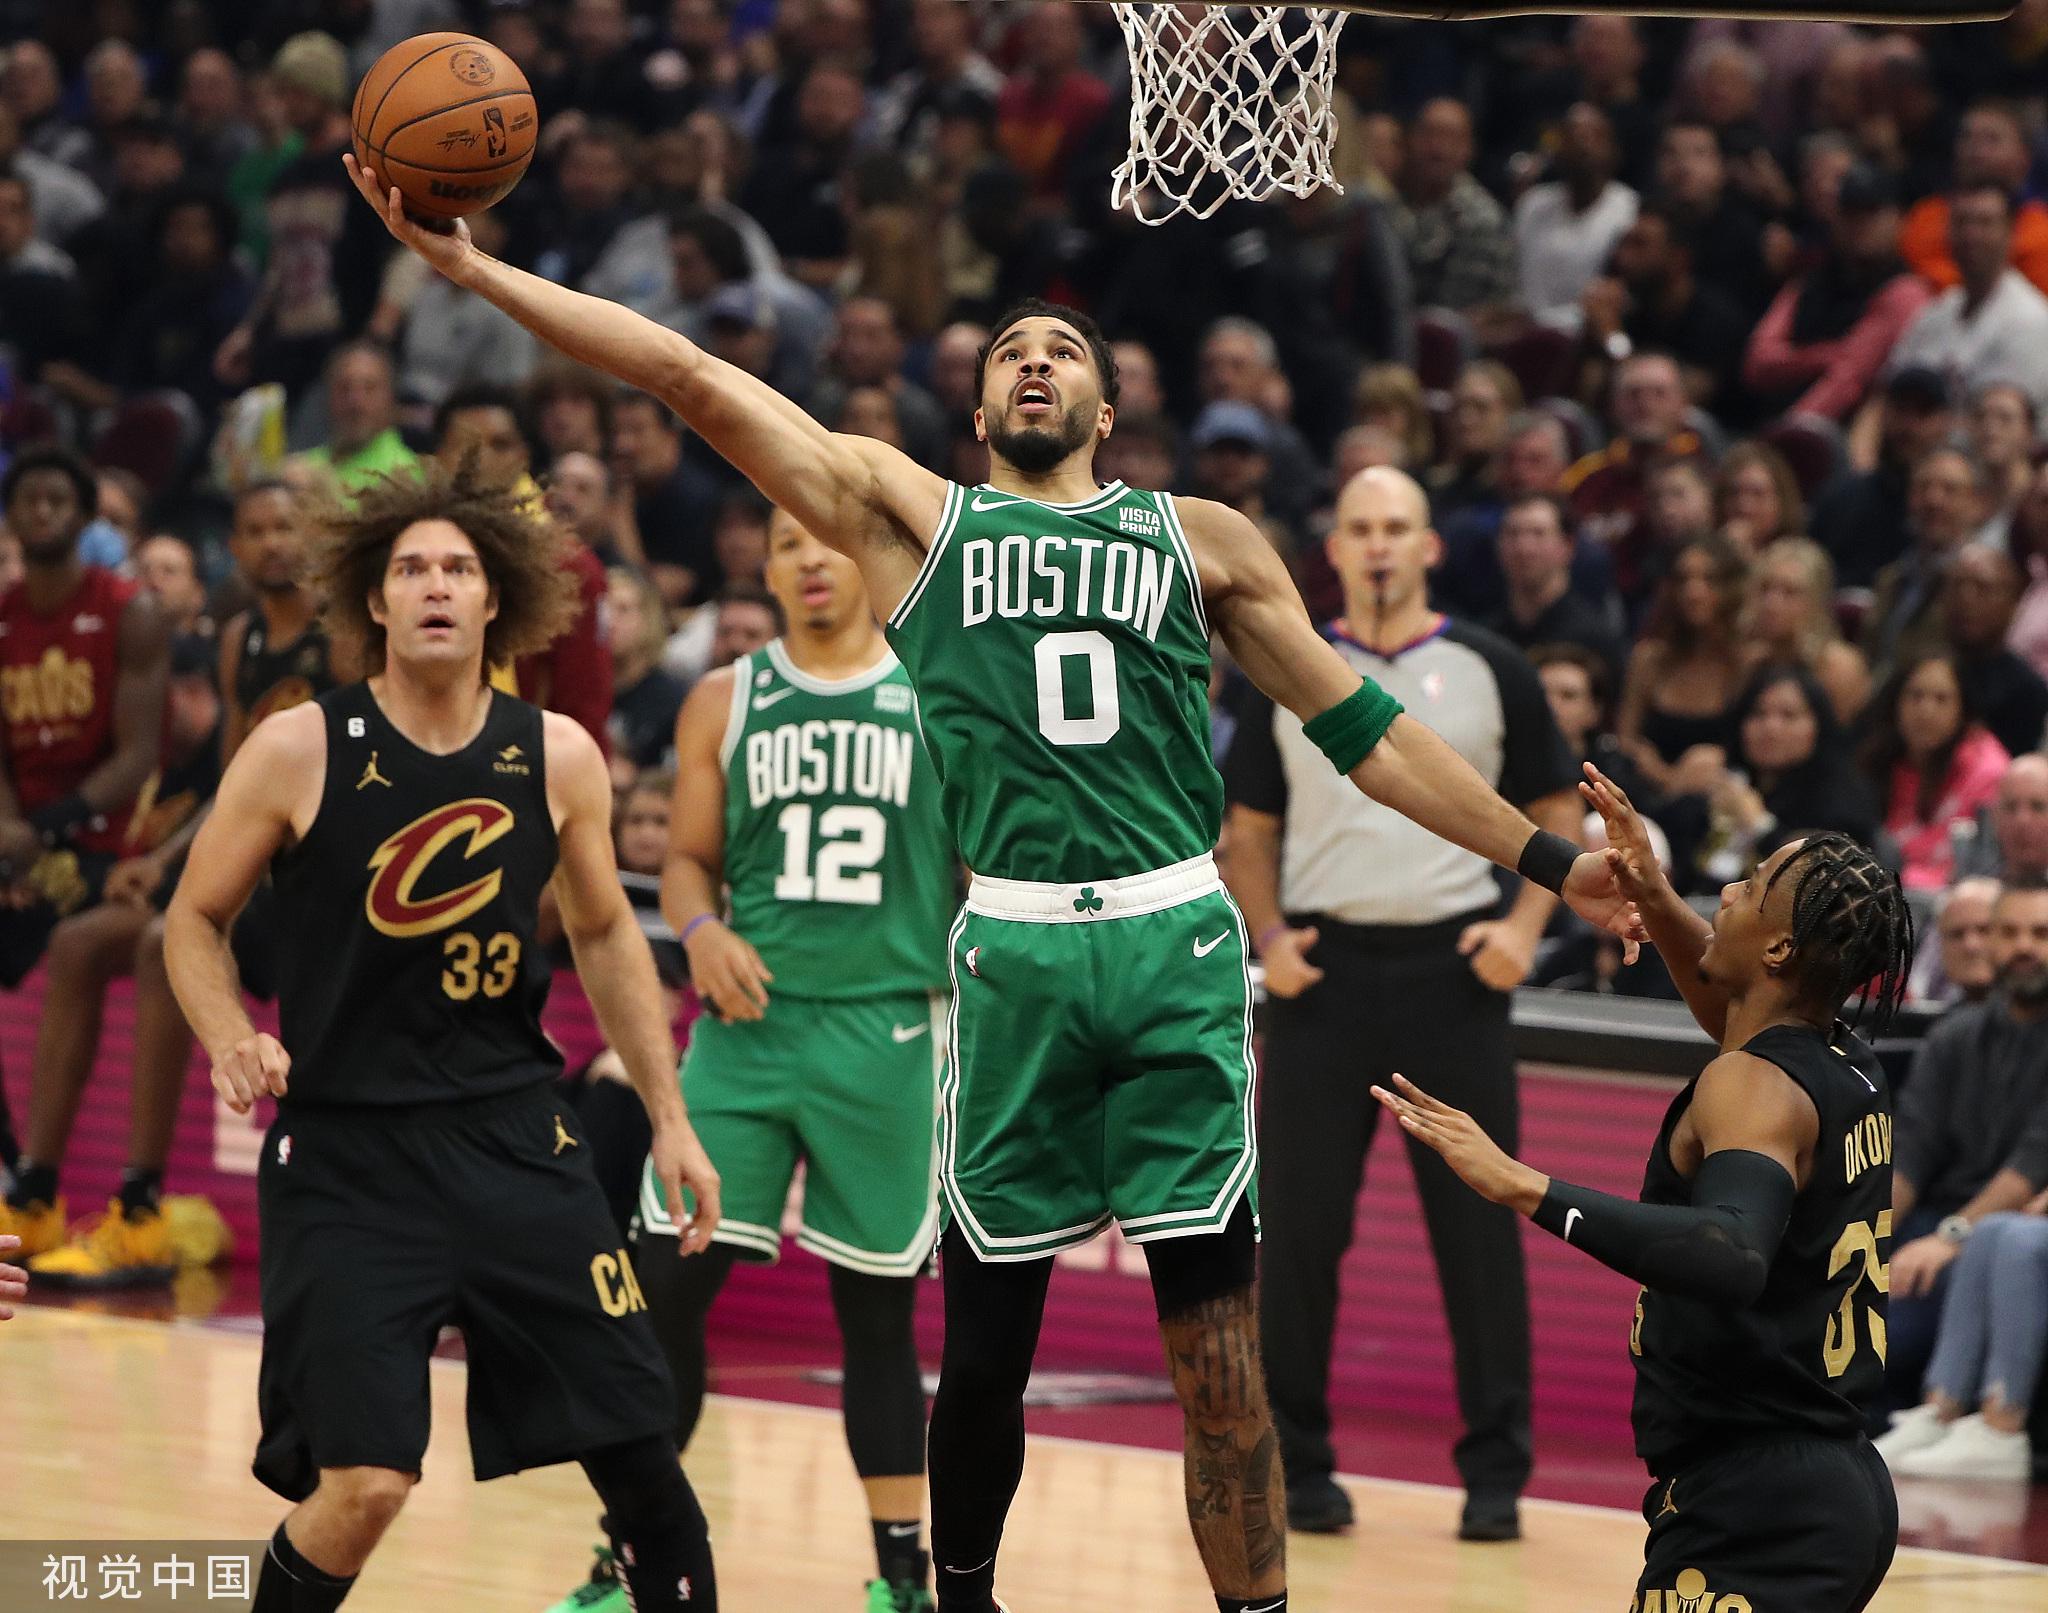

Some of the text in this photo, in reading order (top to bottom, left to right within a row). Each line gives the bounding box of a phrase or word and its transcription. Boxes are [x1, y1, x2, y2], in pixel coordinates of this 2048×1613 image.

[1119, 507, 1161, 527] VISTA
[1119, 521, 1162, 537] PRINT
[963, 535, 1175, 643] BOSTON
[1034, 630, 1120, 746] 0
[746, 719, 914, 809] BOSTON
[774, 803, 887, 905] 12
[441, 931, 522, 1001] 33
[1844, 1112, 1893, 1185] OKOR
